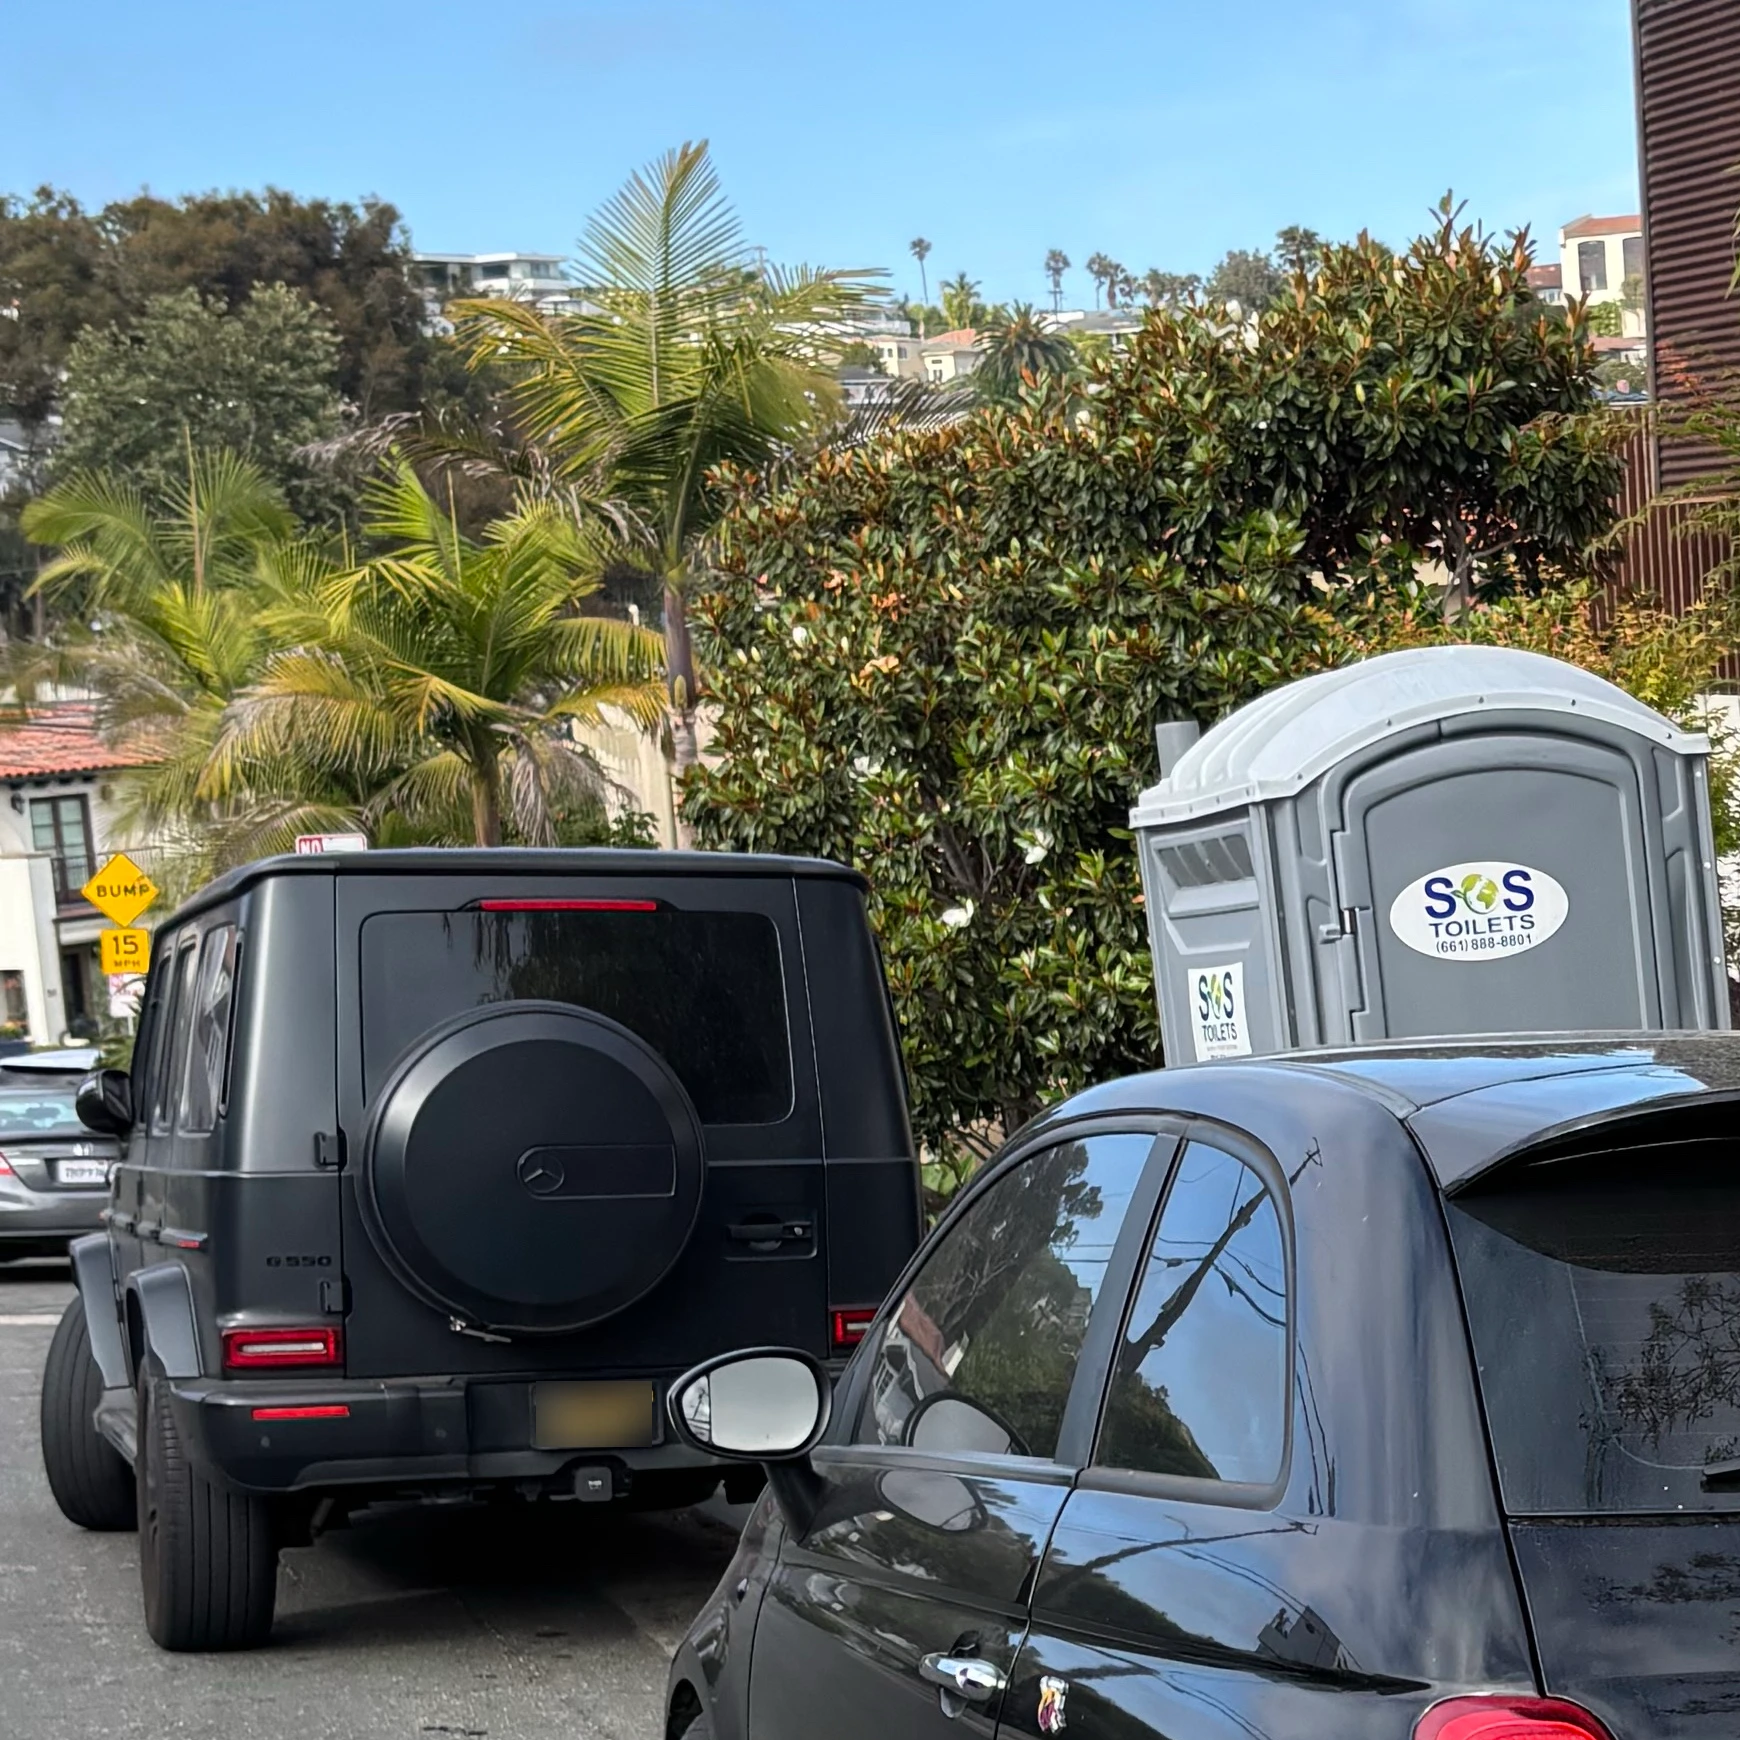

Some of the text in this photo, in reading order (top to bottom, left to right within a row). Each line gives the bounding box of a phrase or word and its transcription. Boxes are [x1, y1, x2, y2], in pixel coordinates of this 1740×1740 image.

[96, 884, 150, 898] BUMP
[1429, 914, 1535, 938] TOILETS
[113, 935, 139, 955] 15
[1471, 934, 1532, 950] 888-8801
[1202, 1022, 1238, 1042] TOILETS
